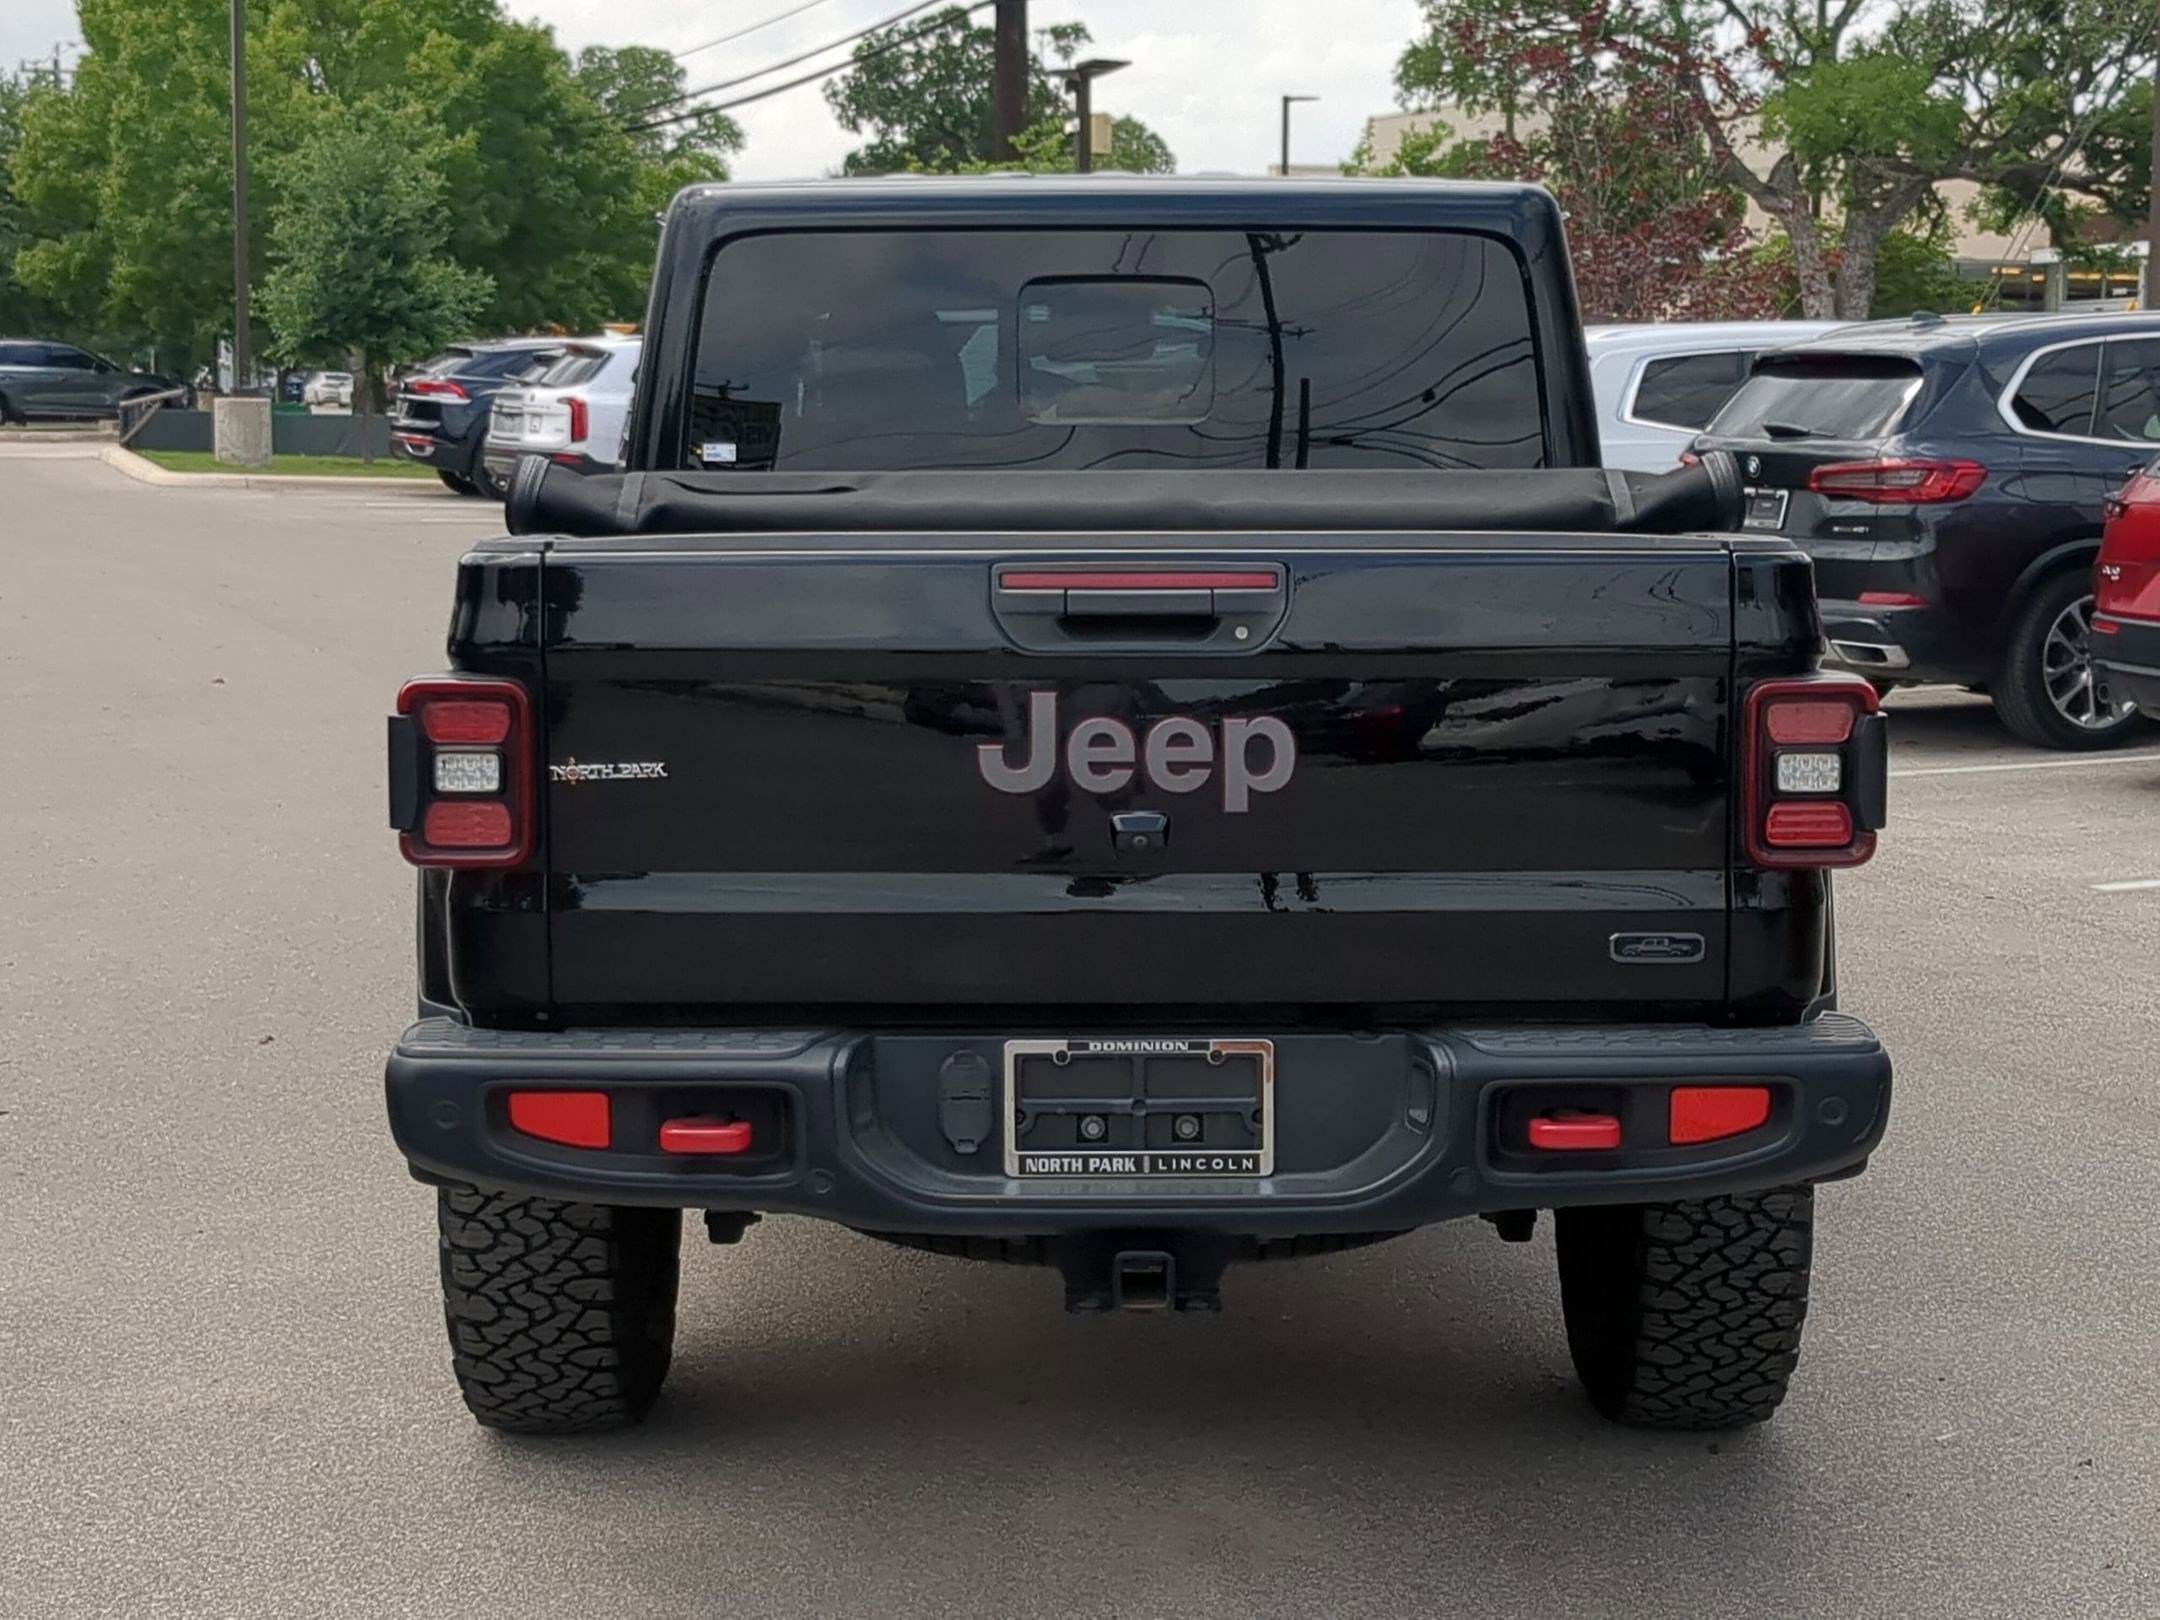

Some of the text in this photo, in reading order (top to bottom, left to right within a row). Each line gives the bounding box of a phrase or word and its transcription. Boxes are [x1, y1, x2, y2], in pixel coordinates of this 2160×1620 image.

[976, 691, 1296, 813] Jeep
[549, 759, 669, 784] NORTH PARK
[1088, 1041, 1190, 1051] DOMINION
[1025, 1157, 1254, 1173] NORTH PARK LINCOLN
